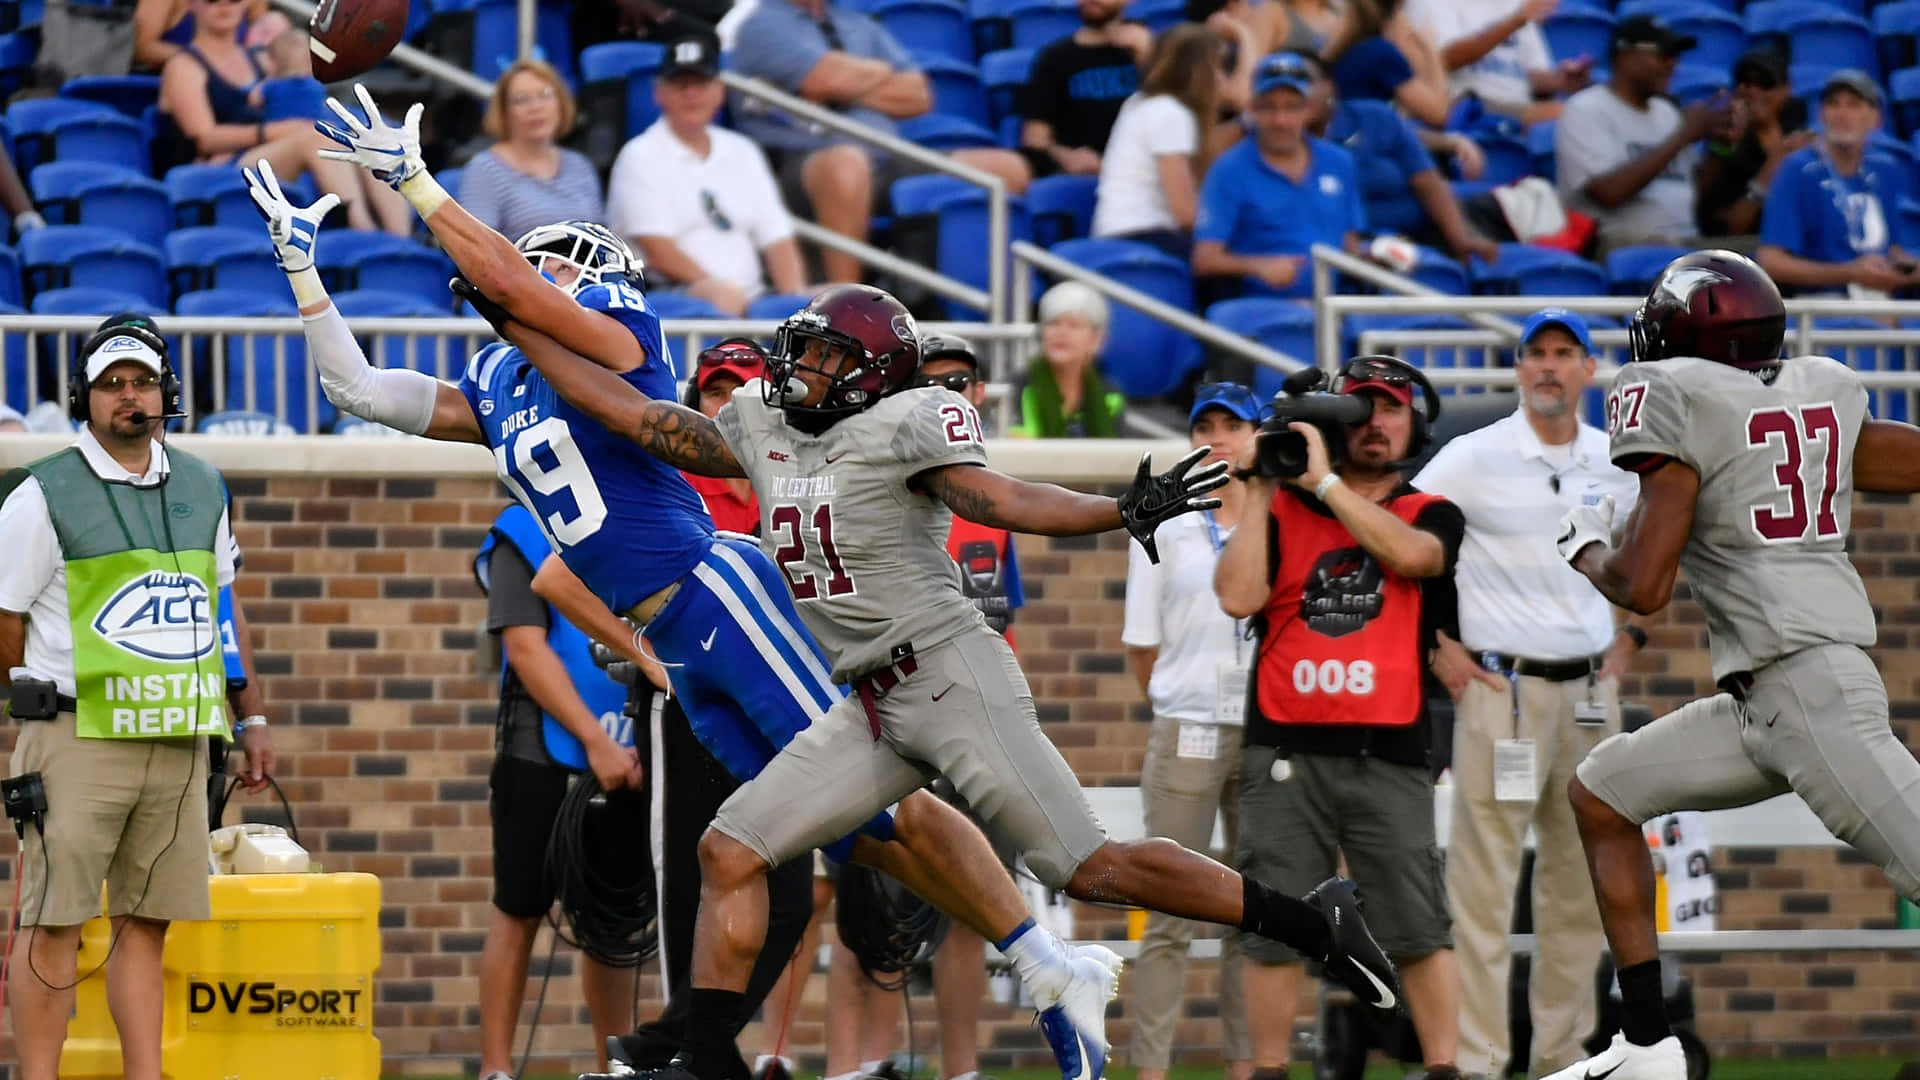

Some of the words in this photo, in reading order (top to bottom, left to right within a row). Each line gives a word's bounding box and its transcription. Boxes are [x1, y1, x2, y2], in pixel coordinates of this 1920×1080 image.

[605, 282, 646, 312] 19
[501, 405, 539, 440] DUKE
[938, 404, 984, 446] 21
[493, 416, 608, 554] 19
[770, 476, 786, 498] NC
[787, 475, 836, 497] CENTRAL
[1745, 401, 1842, 544] 37
[770, 503, 858, 602] 21
[120, 595, 209, 629] ACC
[1293, 659, 1375, 695] 008
[276, 1016, 357, 1027] SOFTWARE
